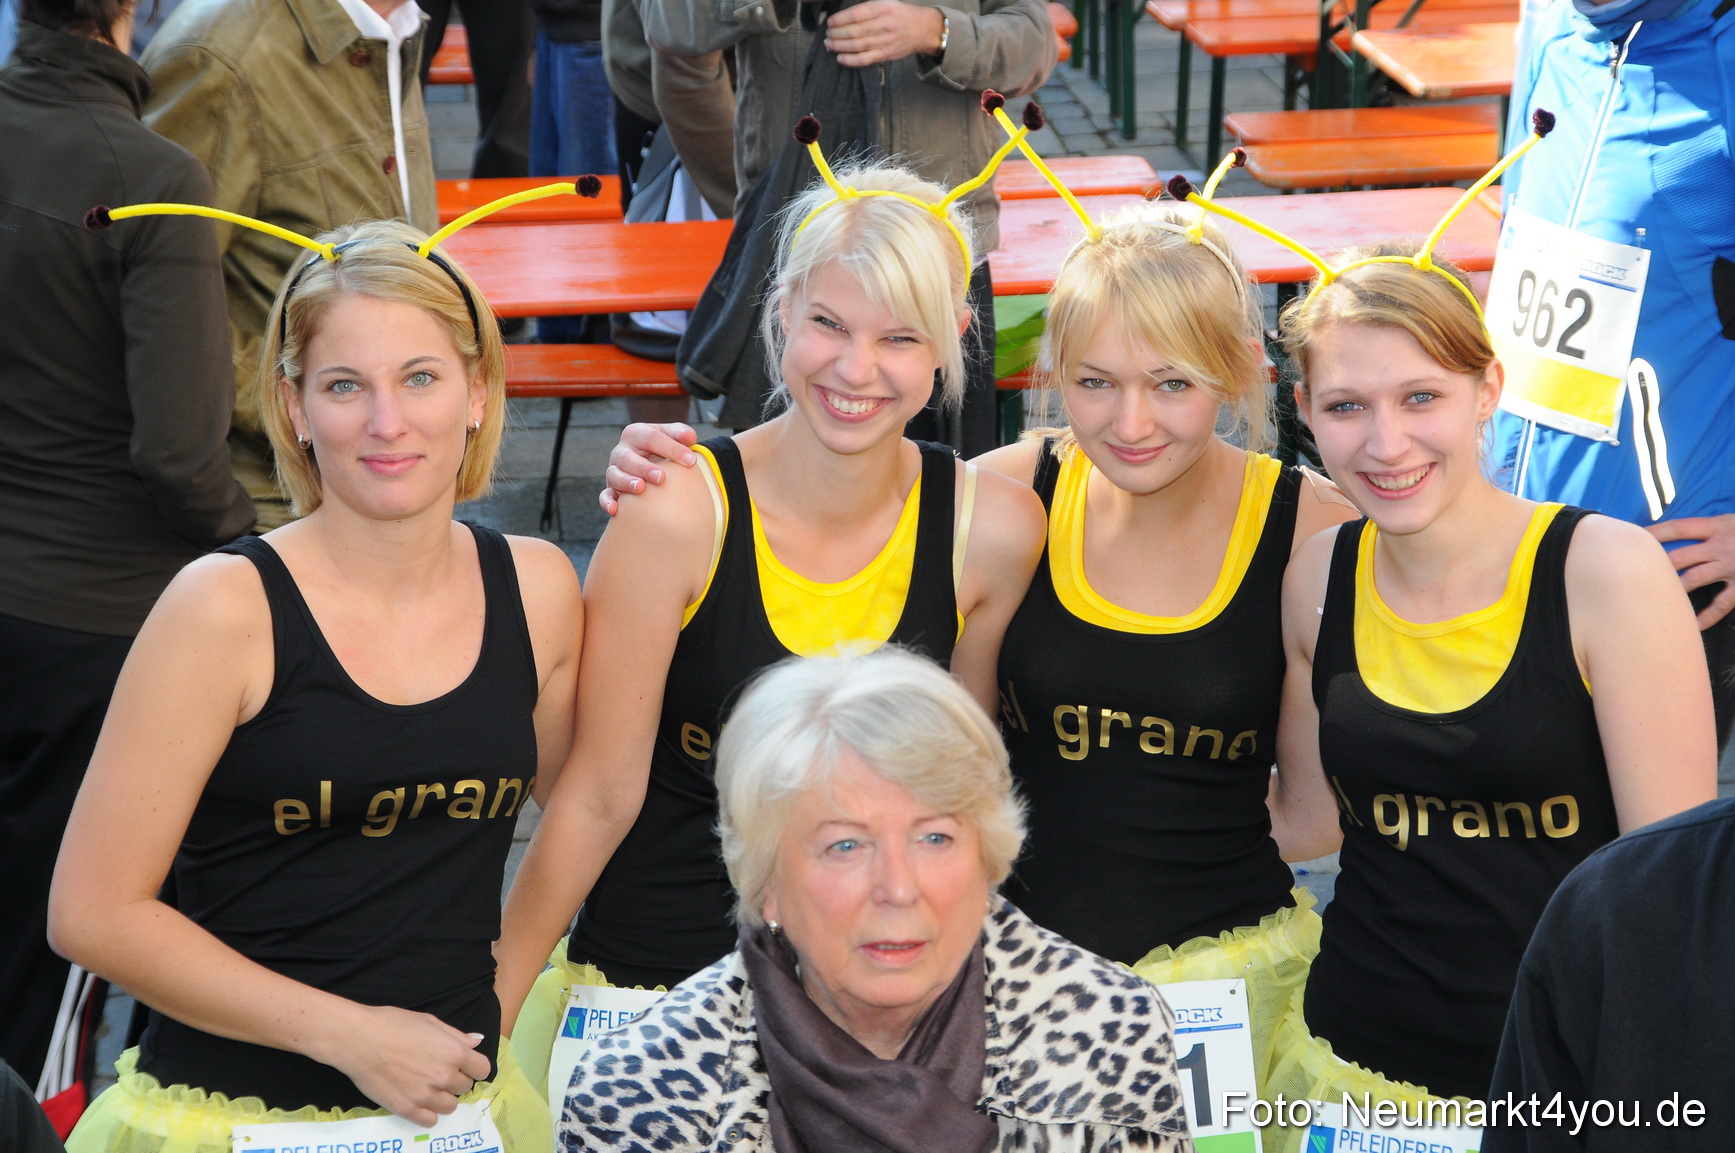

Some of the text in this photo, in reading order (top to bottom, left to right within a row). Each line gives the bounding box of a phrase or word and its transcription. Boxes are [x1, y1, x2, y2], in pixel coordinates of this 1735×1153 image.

[1513, 269, 1594, 360] 962
[1053, 704, 1258, 761] grano
[273, 780, 332, 835] el
[1373, 793, 1580, 851] grano
[588, 1008, 644, 1029] PFLE
[1175, 1007, 1223, 1024] OCK
[430, 1130, 484, 1153] BOCK
